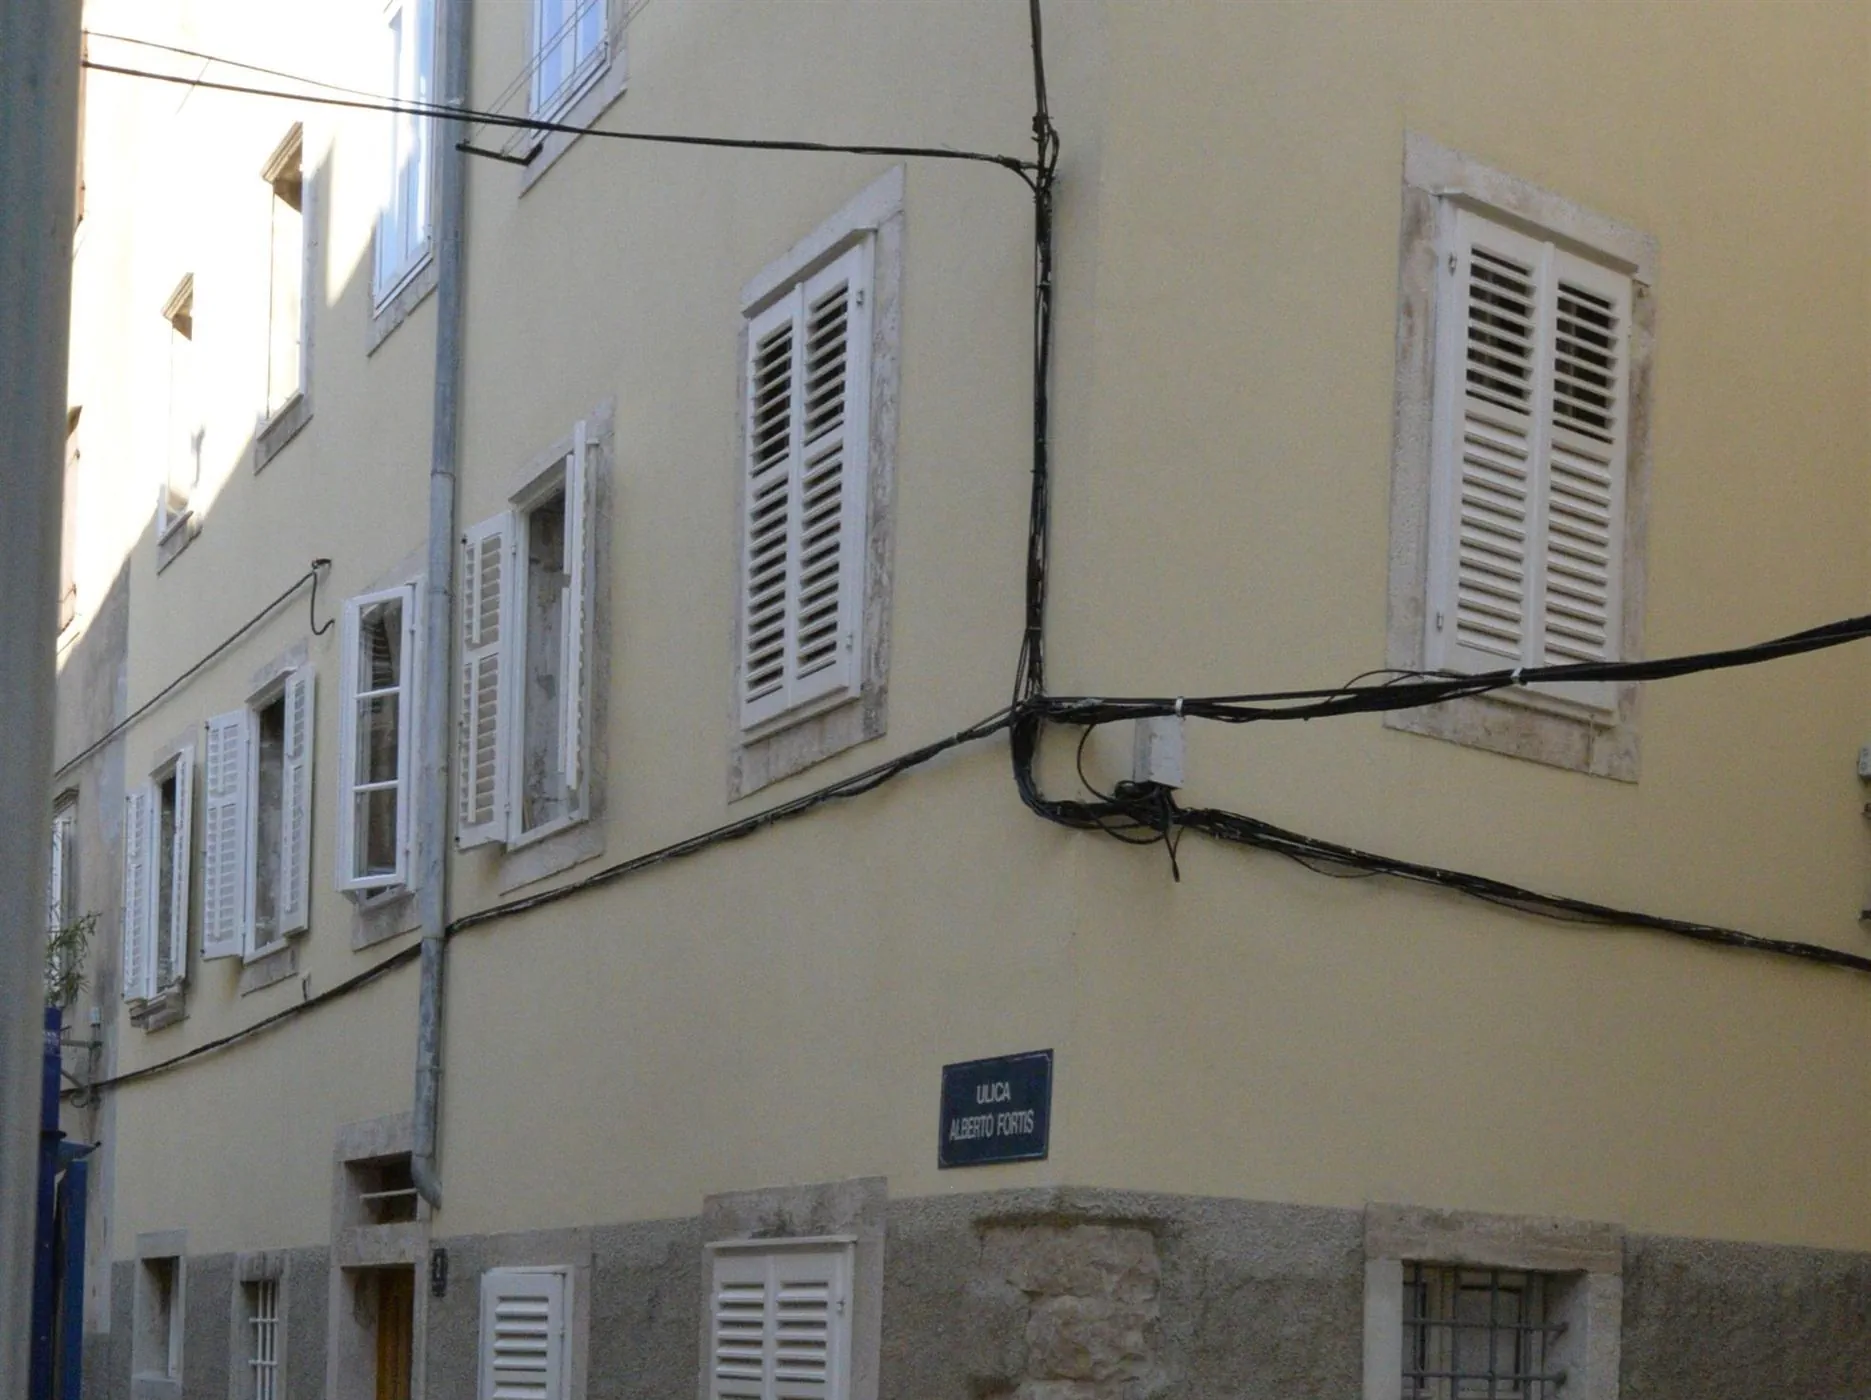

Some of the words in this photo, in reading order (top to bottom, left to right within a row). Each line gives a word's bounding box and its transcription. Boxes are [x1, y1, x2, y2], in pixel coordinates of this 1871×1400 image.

[976, 1081, 1011, 1104] ULICA
[950, 1114, 994, 1141] ALBERTO
[996, 1108, 1034, 1136] FORTIS
